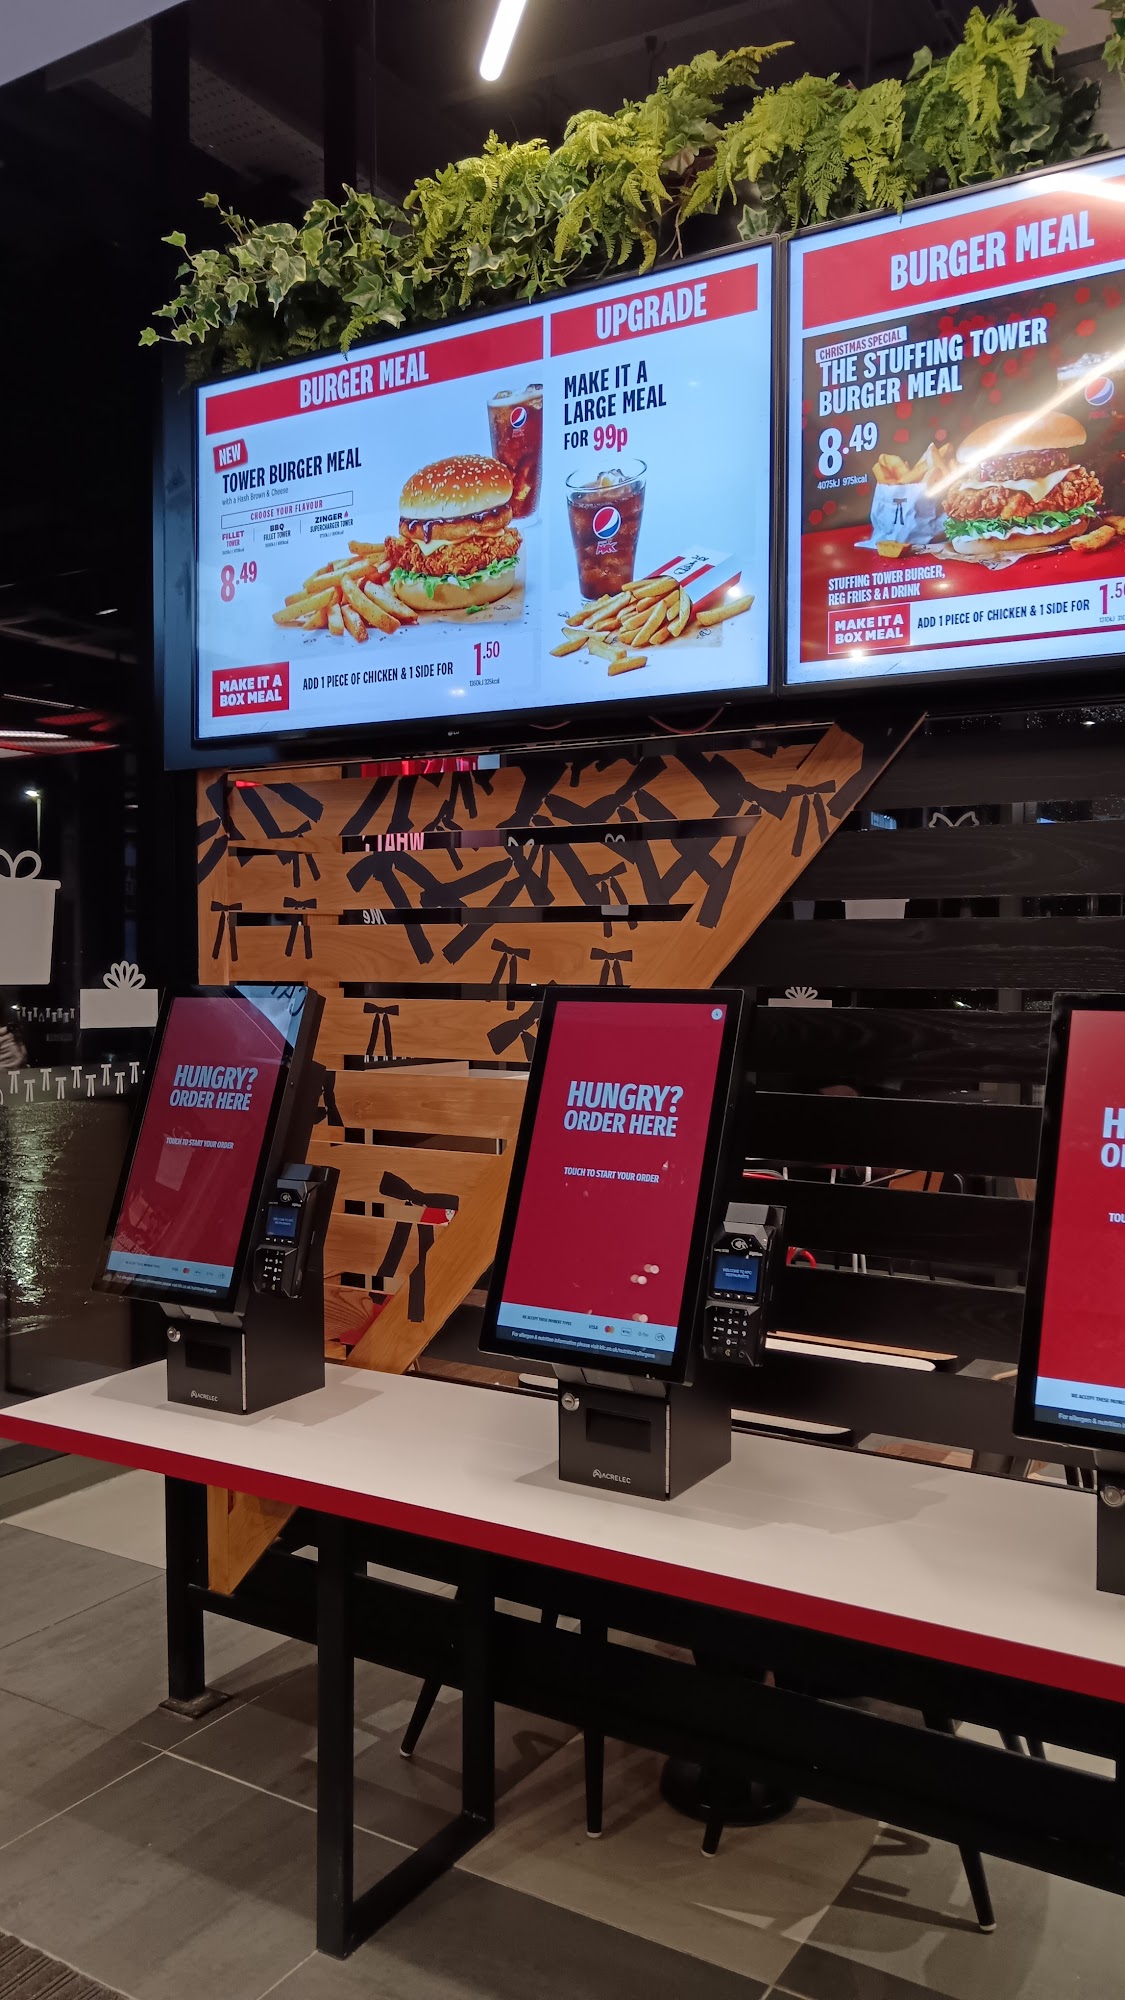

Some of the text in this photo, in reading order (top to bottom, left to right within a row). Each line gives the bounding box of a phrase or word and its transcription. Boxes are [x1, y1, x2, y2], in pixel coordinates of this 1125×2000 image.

[891, 210, 1095, 291] BURGER MEAL
[596, 282, 707, 340] UPGRADE
[820, 330, 902, 361] CHRISTMAS SPECIAL
[820, 317, 1047, 388] THE STUFFING TOWER
[300, 350, 430, 409] BURGER MEAL
[564, 360, 648, 400] MAKE IT A
[819, 366, 963, 417] BURGER MEAL
[564, 383, 666, 426] LARGE MEAL
[564, 423, 628, 453] FOR 99p
[818, 421, 878, 477] 8.49
[218, 442, 242, 467] NEW
[222, 447, 362, 494] TOWER BURGER MEAL
[817, 474, 868, 491] 4075kJ 975kcal
[222, 497, 232, 506] with
[238, 494, 250, 504] Hash
[250, 490, 266, 500] Brown
[266, 490, 270, 498] &
[271, 486, 288, 496] Cheese
[250, 500, 323, 521] CHOOSE YOUR FLAVOUR
[314, 512, 343, 524] ZINGER
[222, 530, 244, 541] FILLET
[263, 530, 292, 542] FILLET TOWER
[270, 523, 285, 532] BBQ
[310, 518, 354, 534] SUPERCHARGER TOWER
[226, 539, 240, 548] TOWER
[220, 560, 258, 603] 8.49
[828, 564, 946, 592] STUFFING TOWER BURGER,
[828, 583, 920, 606] REG FRIES & A DRINK
[1100, 582, 1125, 615] 1.5
[834, 613, 904, 632] MAKE IT A
[918, 598, 1090, 629] ADD 1 PIECE OF CHICKEN & 1 SIDE FOR
[835, 626, 904, 645] BOX MEAL
[474, 640, 500, 676] 1.50
[219, 674, 283, 694] MAKE IT A
[303, 661, 454, 692] ADD 1 PIECE OF CHICKEN & 1 SIDE FOR
[219, 689, 282, 708] BOX MEAL
[173, 1064, 258, 1091] HUNGRY?
[170, 1088, 252, 1111] ORDER HERE
[566, 1080, 684, 1114] HUNGRY?
[563, 1110, 678, 1138] ORDER HERE
[166, 1136, 234, 1150] TOUCH TO START YOUR ORDER
[564, 1166, 660, 1183] TOUCH TO START YOUR ORDER
[1058, 1412, 1068, 1420] For
[1068, 1414, 1092, 1424] allergen
[602, 1472, 631, 1484] ACRELEC
